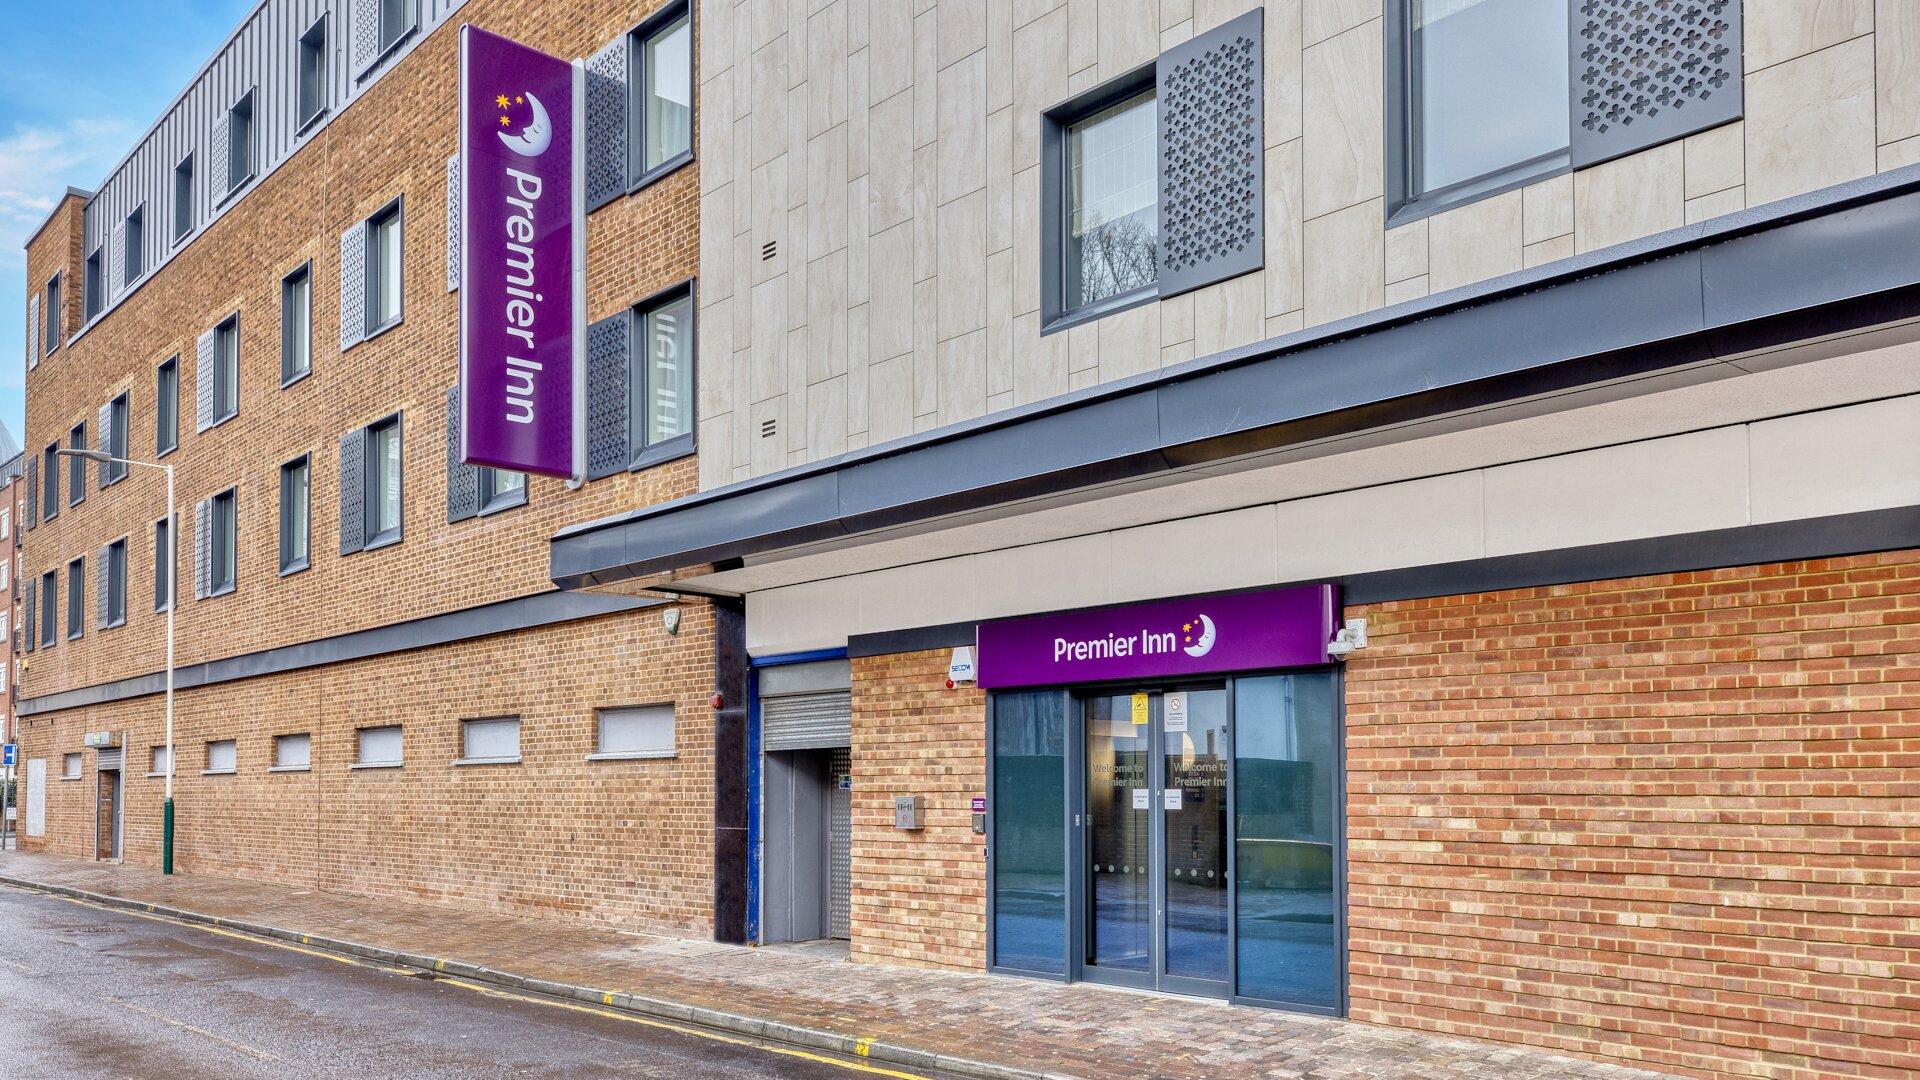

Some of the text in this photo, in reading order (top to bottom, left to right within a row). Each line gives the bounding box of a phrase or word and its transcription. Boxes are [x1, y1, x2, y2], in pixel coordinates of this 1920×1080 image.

[506, 167, 543, 424] Premier Inn
[1054, 629, 1176, 663] Premier Inn
[951, 664, 971, 672] SECOM
[1093, 763, 1144, 773] Welcome to
[1173, 762, 1217, 772] Welcome
[1129, 778, 1143, 787] Inn
[1174, 776, 1212, 787] Premier
